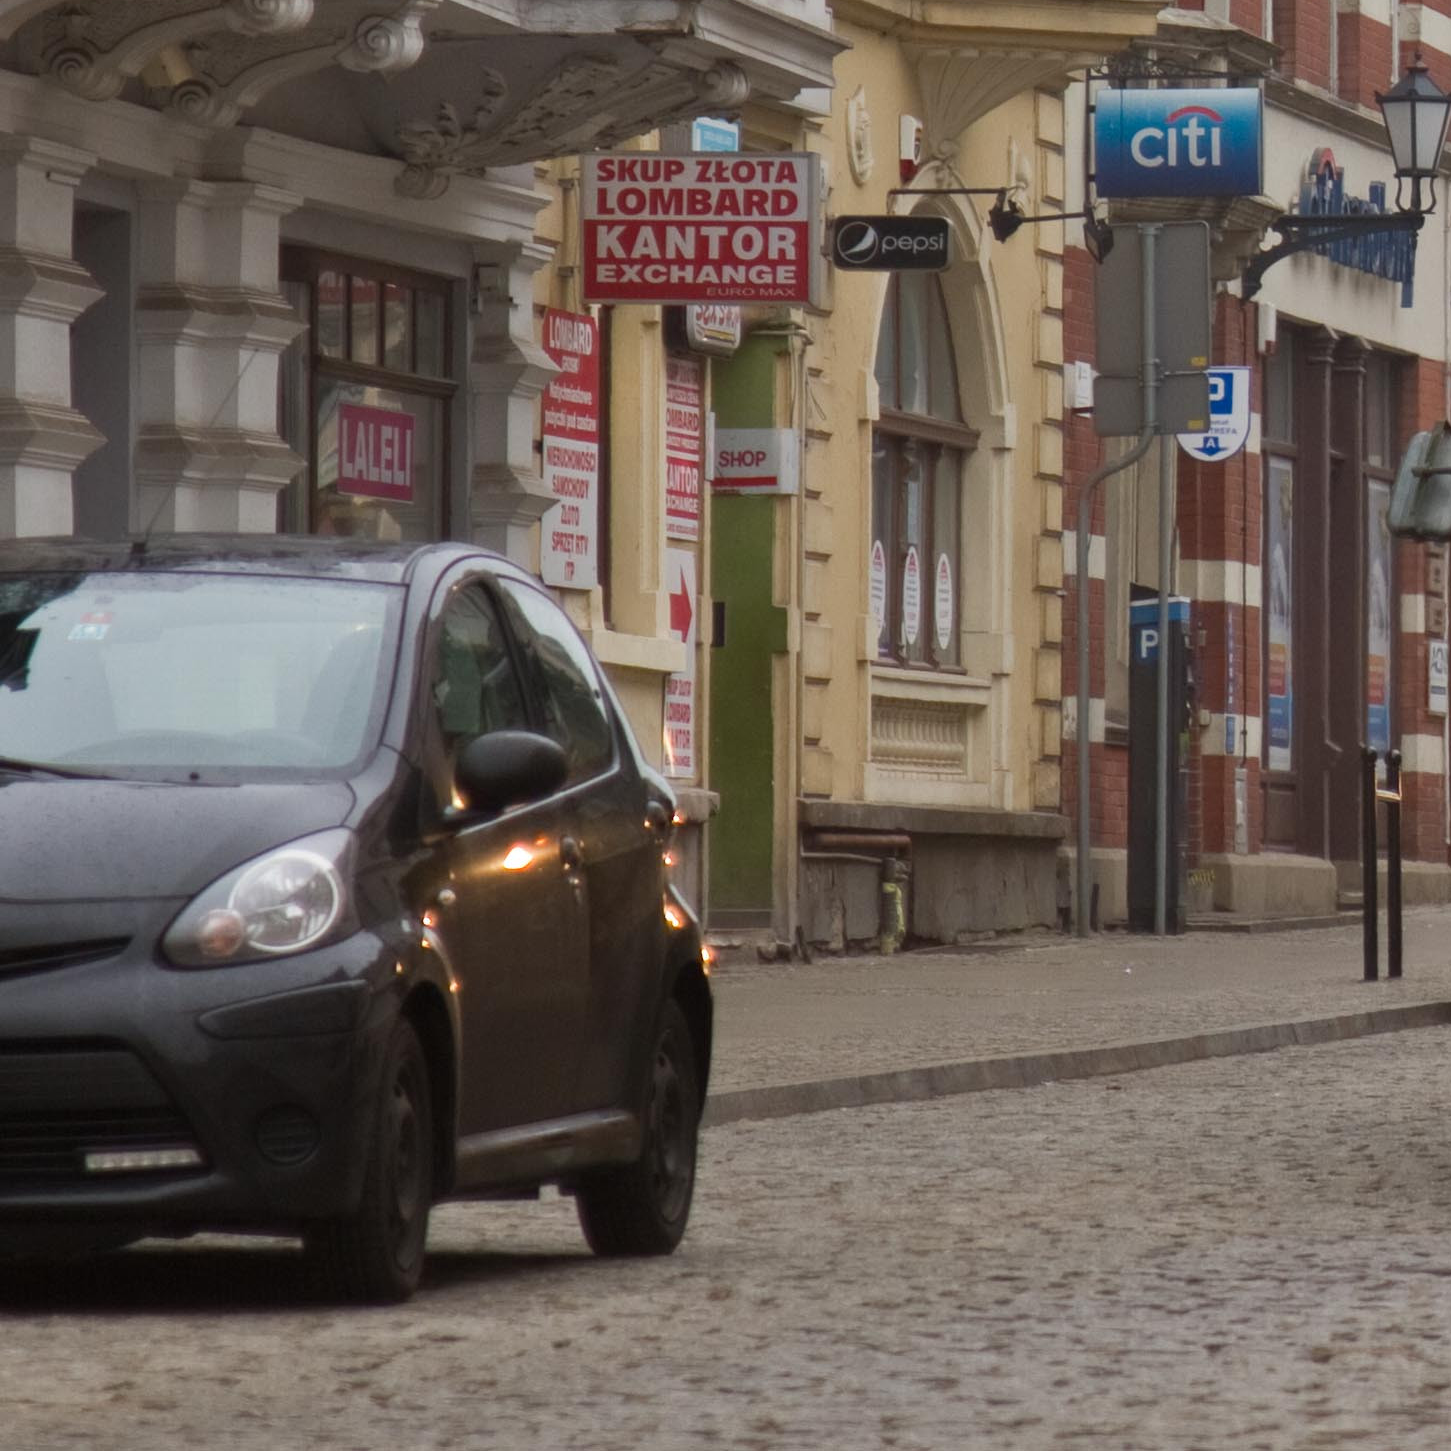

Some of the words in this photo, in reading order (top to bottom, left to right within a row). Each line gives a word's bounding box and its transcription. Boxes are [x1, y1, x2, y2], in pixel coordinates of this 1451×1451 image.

[1131, 116, 1222, 168] citi
[596, 158, 685, 183] SKUP
[695, 159, 798, 184] ZŁOTA
[596, 187, 798, 217] LOMBARD
[596, 224, 797, 261] KANTOR
[882, 232, 944, 255] pepsi
[596, 264, 797, 285] EXCHANGE
[706, 286, 755, 296] EURO
[759, 286, 796, 296] MAX
[549, 315, 593, 356] LOMBARD
[666, 407, 699, 432] OMBARD
[1209, 427, 1238, 435] TREFA
[342, 418, 412, 487] LALELI
[1205, 437, 1217, 448] A
[718, 450, 767, 468] SHOP
[552, 474, 589, 500] SAMOCHODY
[667, 463, 698, 494] ANTOR
[1141, 629, 1159, 659] P
